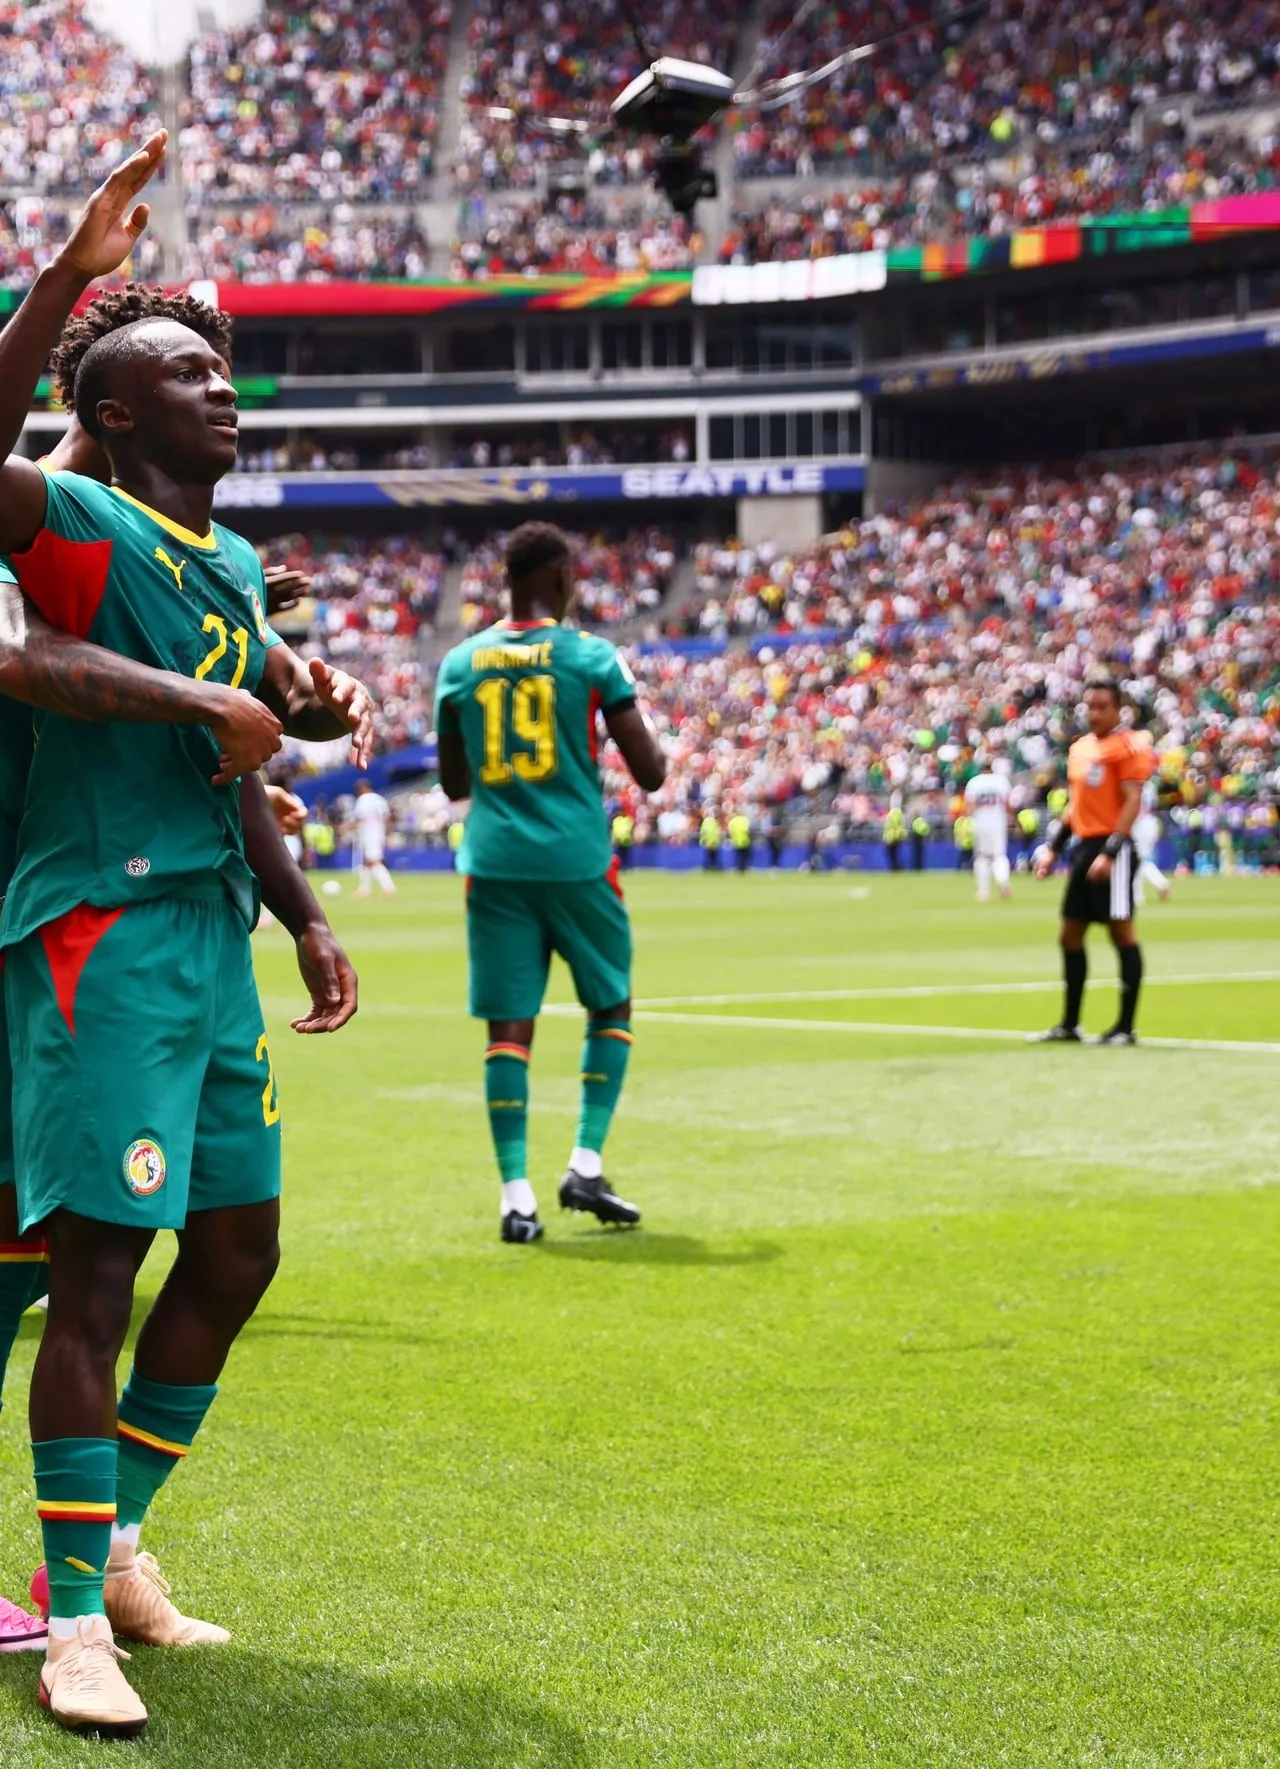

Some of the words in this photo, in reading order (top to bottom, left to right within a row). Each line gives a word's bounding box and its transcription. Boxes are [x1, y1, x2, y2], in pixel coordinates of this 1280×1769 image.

[621, 464, 824, 498] SEATTLE
[195, 613, 249, 689] 21
[475, 676, 556, 782] 19
